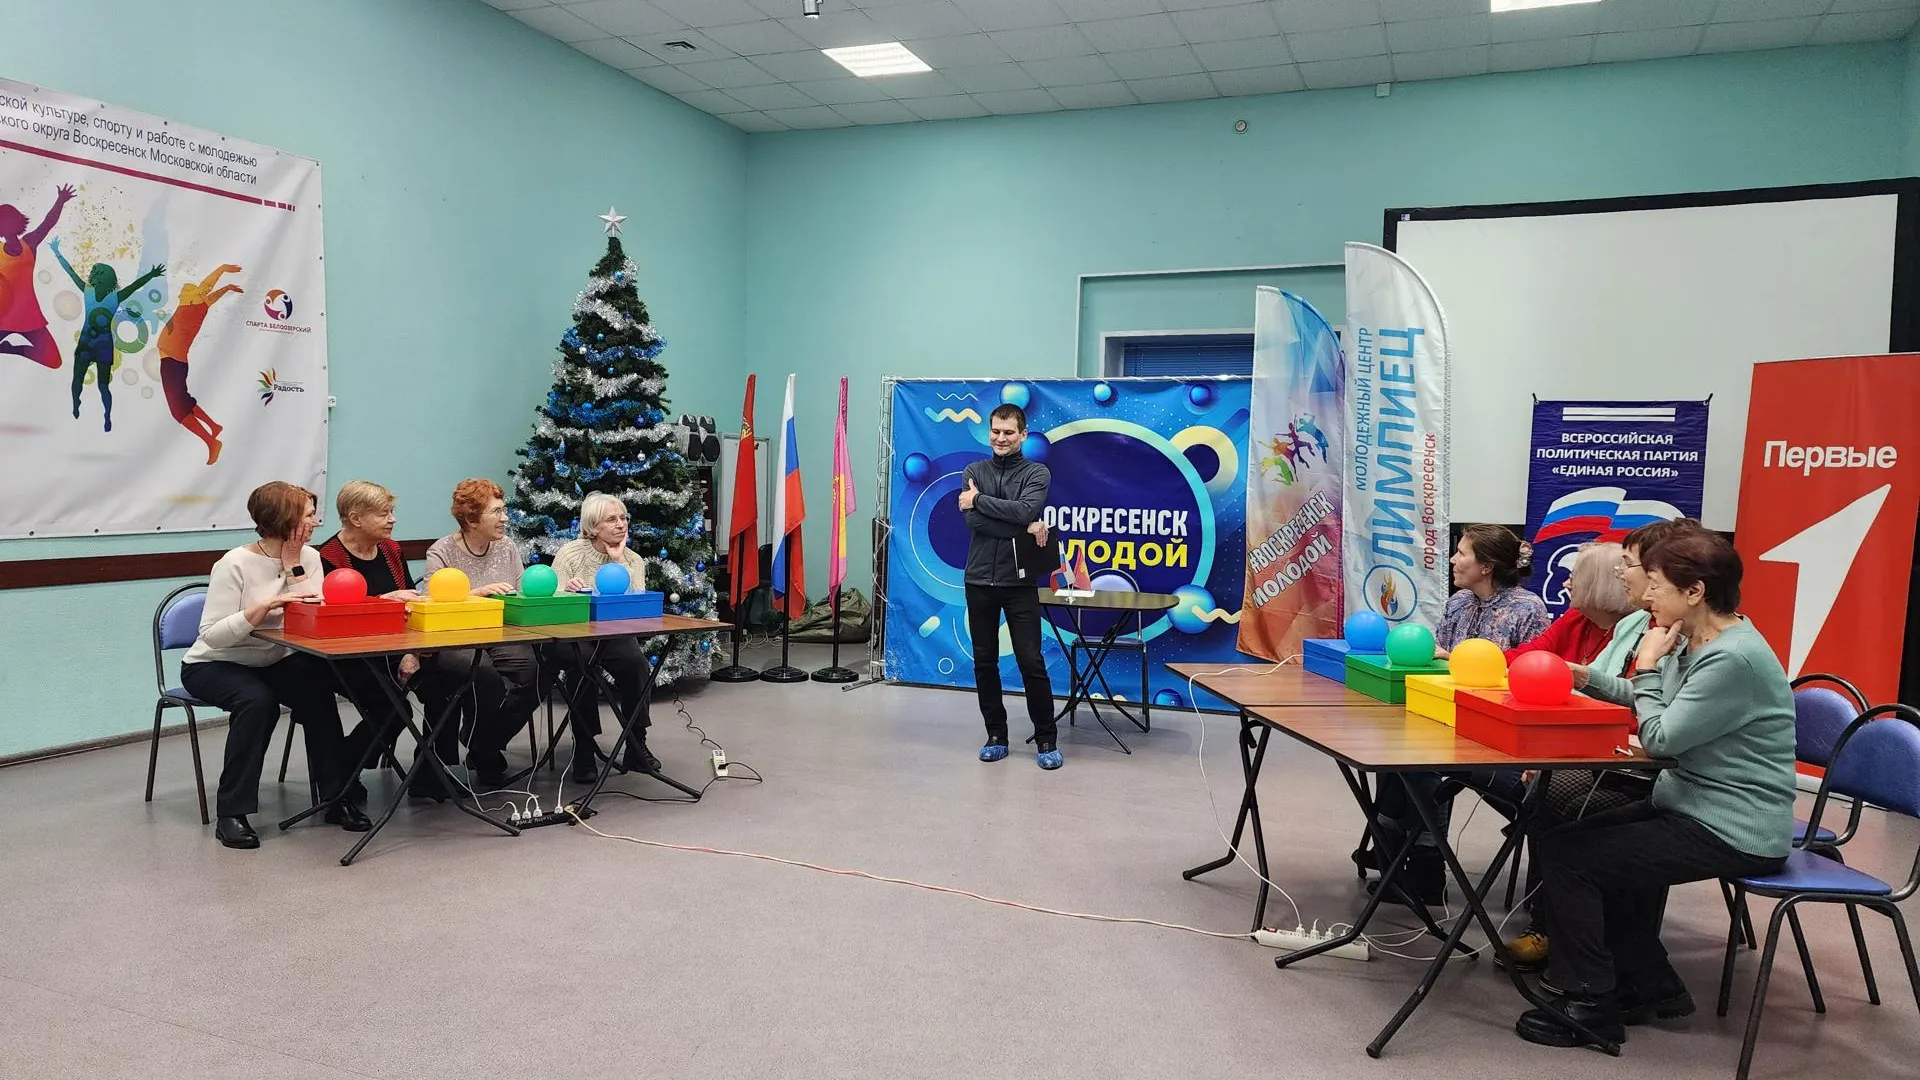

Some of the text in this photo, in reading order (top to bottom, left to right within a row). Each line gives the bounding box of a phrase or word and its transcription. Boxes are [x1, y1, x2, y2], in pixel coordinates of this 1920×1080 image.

[0, 115, 257, 185] кого округа Воскресенск Московской области
[32, 102, 89, 127] культуре,
[93, 117, 132, 139] спорту
[136, 128, 143, 139] и
[147, 131, 186, 149] работе
[189, 141, 196, 152] с
[198, 144, 257, 168] молодежью
[273, 383, 305, 393] Радость
[1355, 327, 1375, 491] МОЛОДЕЖНЫЙ ЦЕНТР
[1536, 448, 1699, 462] ПОЛИТИЧЕСКАЯ ПАРТИЯ
[1561, 431, 1674, 445] ВСЕРОССИЙСКАЯ
[1551, 464, 1679, 478] «ЕДИНАЯ РОССИЯ»
[1763, 440, 1898, 477] Первые
[1421, 432, 1438, 571] город Воскресенск
[1043, 505, 1189, 537] ОСКРЕСЕНСК
[1247, 490, 1336, 574] #ВОСКРЕСЕНСК
[1064, 538, 1188, 571] ЛОДОЙ
[1251, 530, 1335, 609] МОЛОДОЙ
